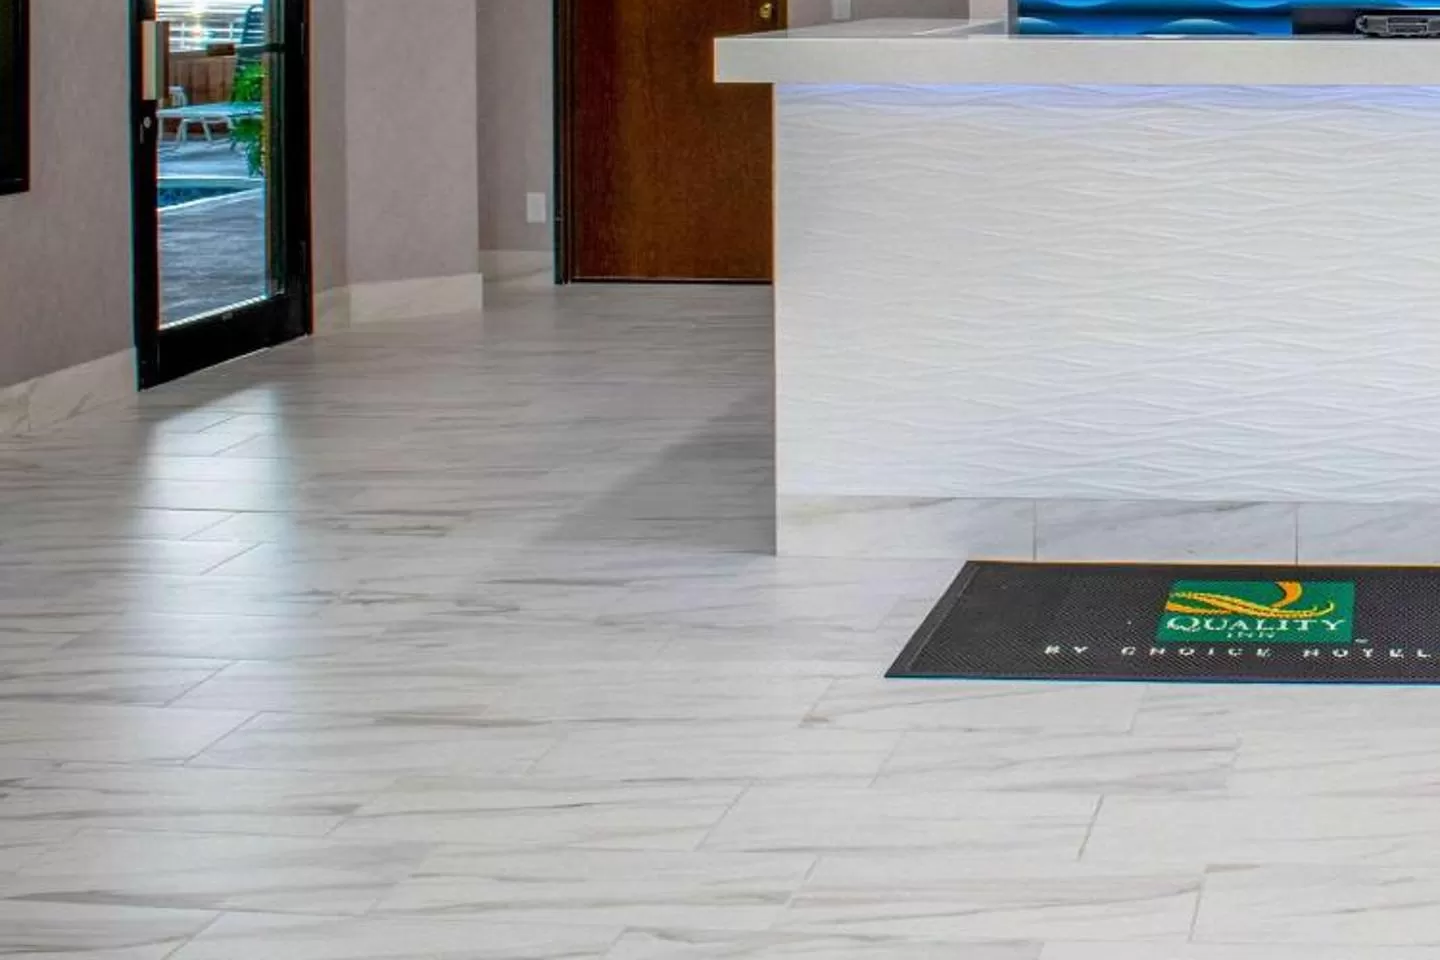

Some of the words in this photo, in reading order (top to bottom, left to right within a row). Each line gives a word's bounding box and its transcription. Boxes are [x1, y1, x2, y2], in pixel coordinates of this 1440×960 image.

[1166, 615, 1346, 633] QUALITY
[1044, 644, 1089, 655] BY
[1121, 645, 1273, 658] CHOICE
